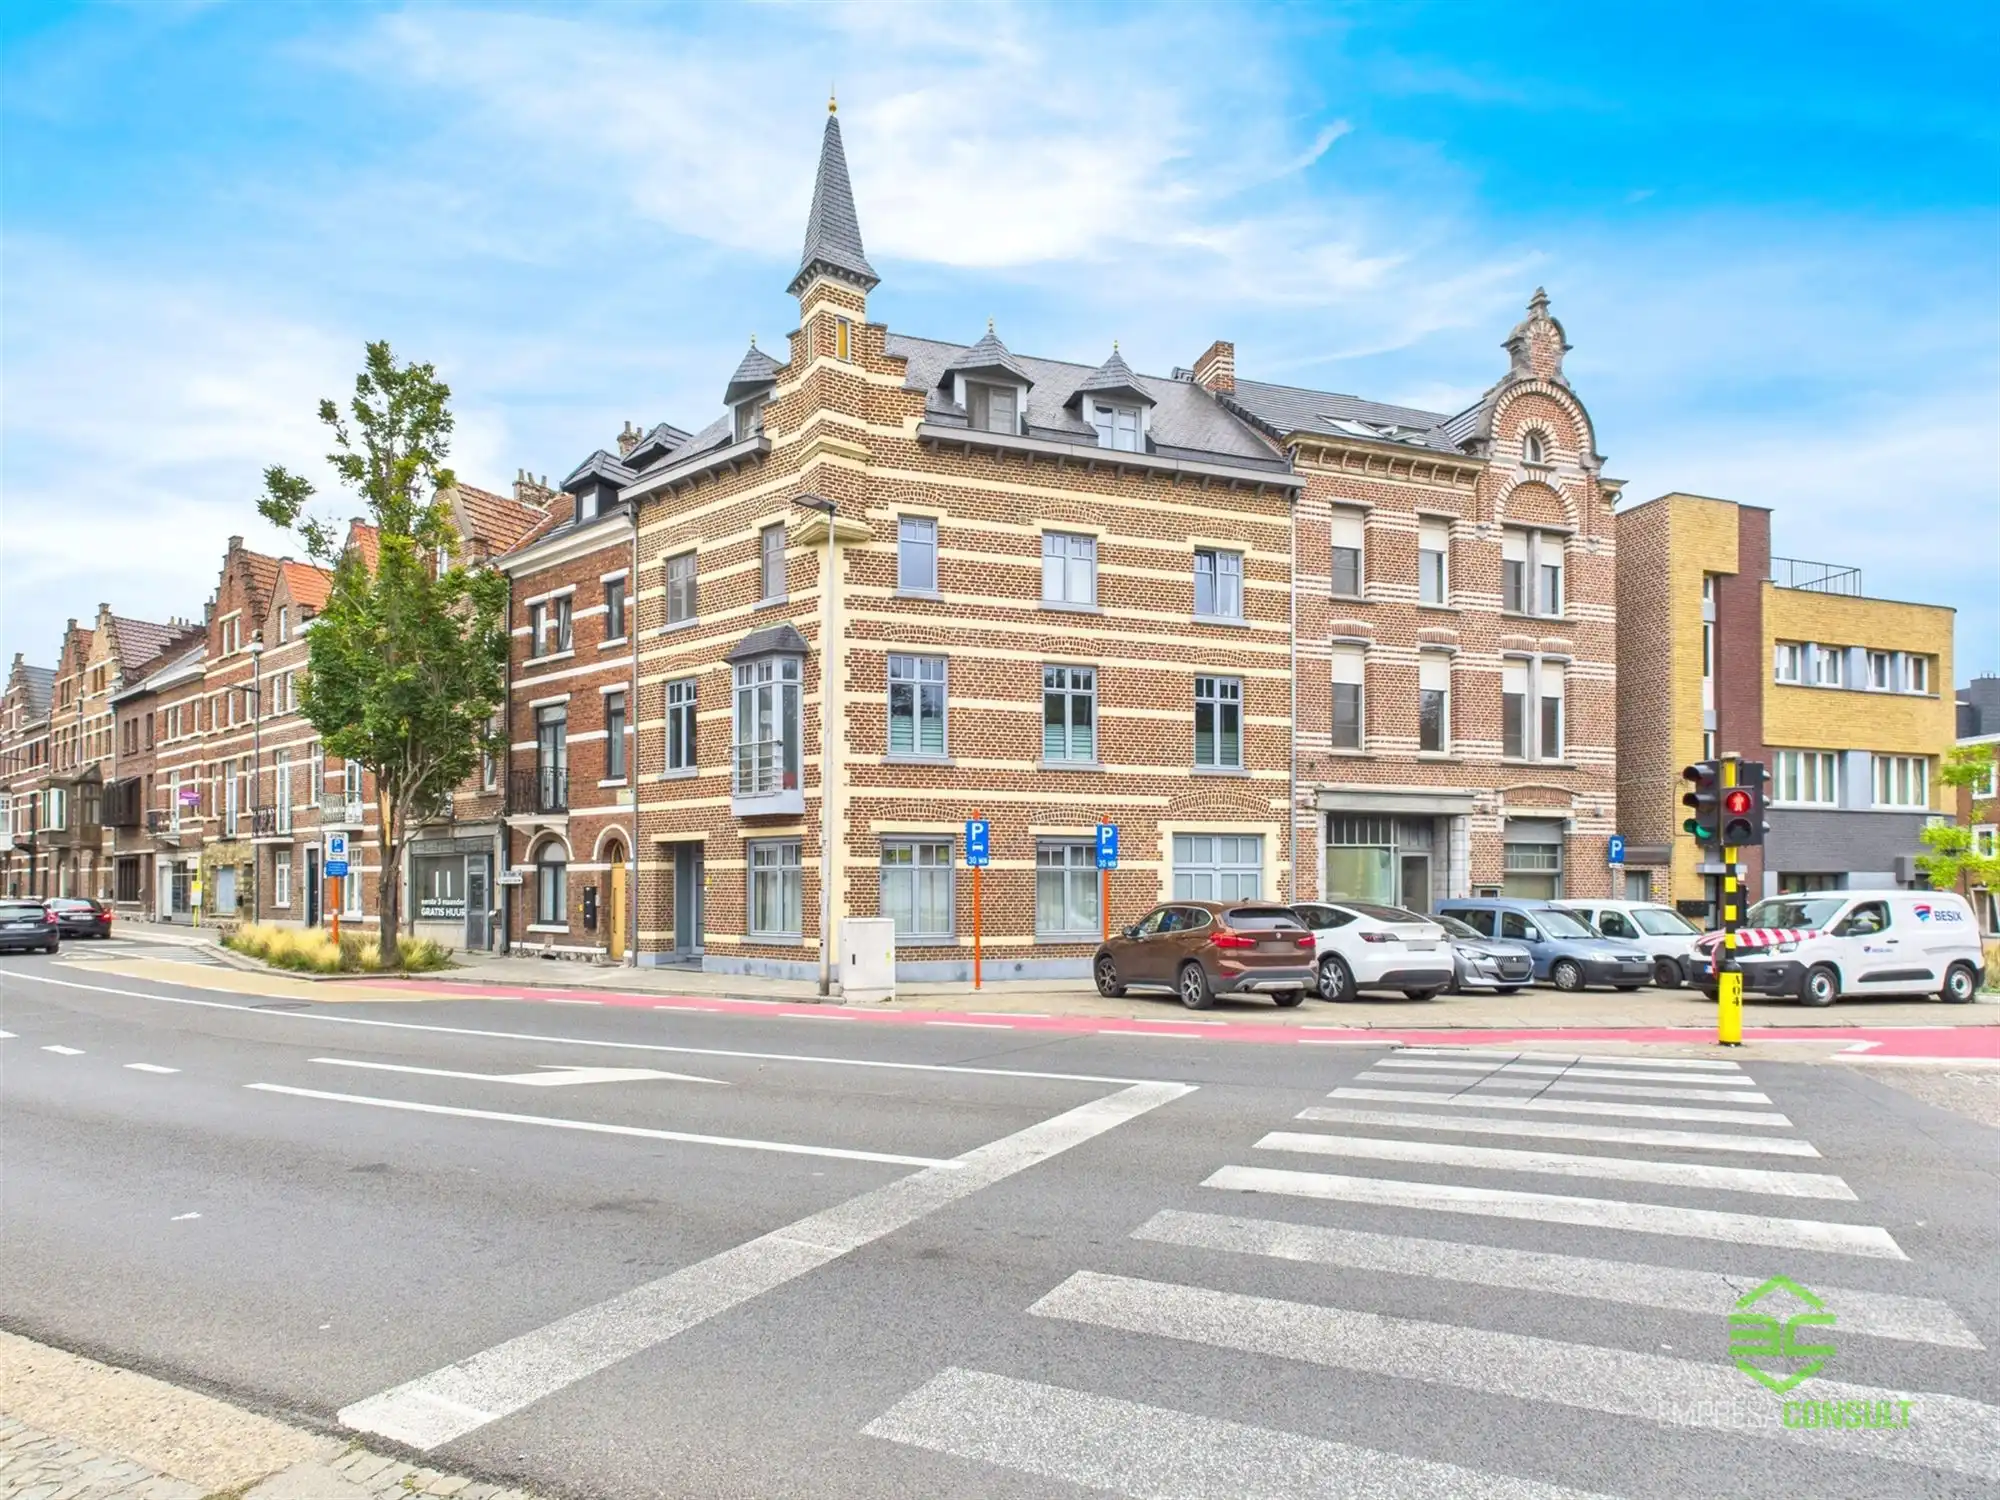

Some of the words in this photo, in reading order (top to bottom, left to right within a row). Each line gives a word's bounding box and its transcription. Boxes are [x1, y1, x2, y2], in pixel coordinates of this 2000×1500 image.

[972, 822, 984, 840] P
[1102, 827, 1113, 844] P
[1612, 839, 1622, 858] P
[968, 855, 977, 865] 30
[421, 907, 444, 916] GRATIS
[445, 907, 466, 917] HUUR
[1934, 910, 1963, 922] BESIX
